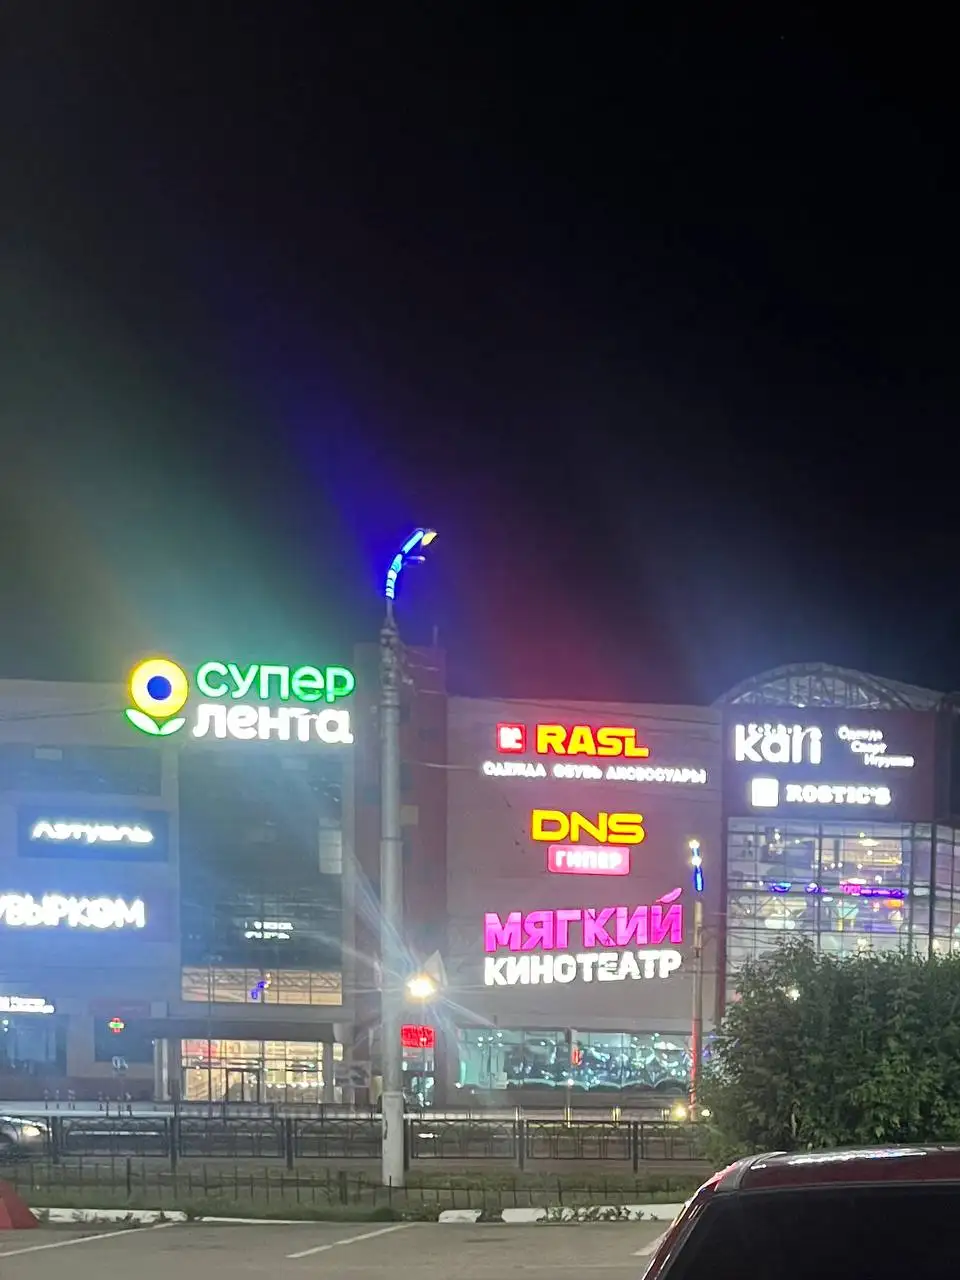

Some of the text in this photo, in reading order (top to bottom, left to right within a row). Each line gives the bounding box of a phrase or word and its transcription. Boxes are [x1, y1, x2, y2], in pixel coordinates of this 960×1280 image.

[196, 661, 355, 702] супер
[192, 703, 354, 744] лента
[536, 723, 650, 758] RASL
[482, 760, 548, 779] ОДЕЖДА
[785, 783, 892, 806] ROSTIC'S
[531, 808, 646, 844] DNS
[555, 849, 624, 870] ГИПЕР
[484, 888, 683, 952] МЯГКИЙ
[483, 948, 682, 987] КИНОТЕАТР
